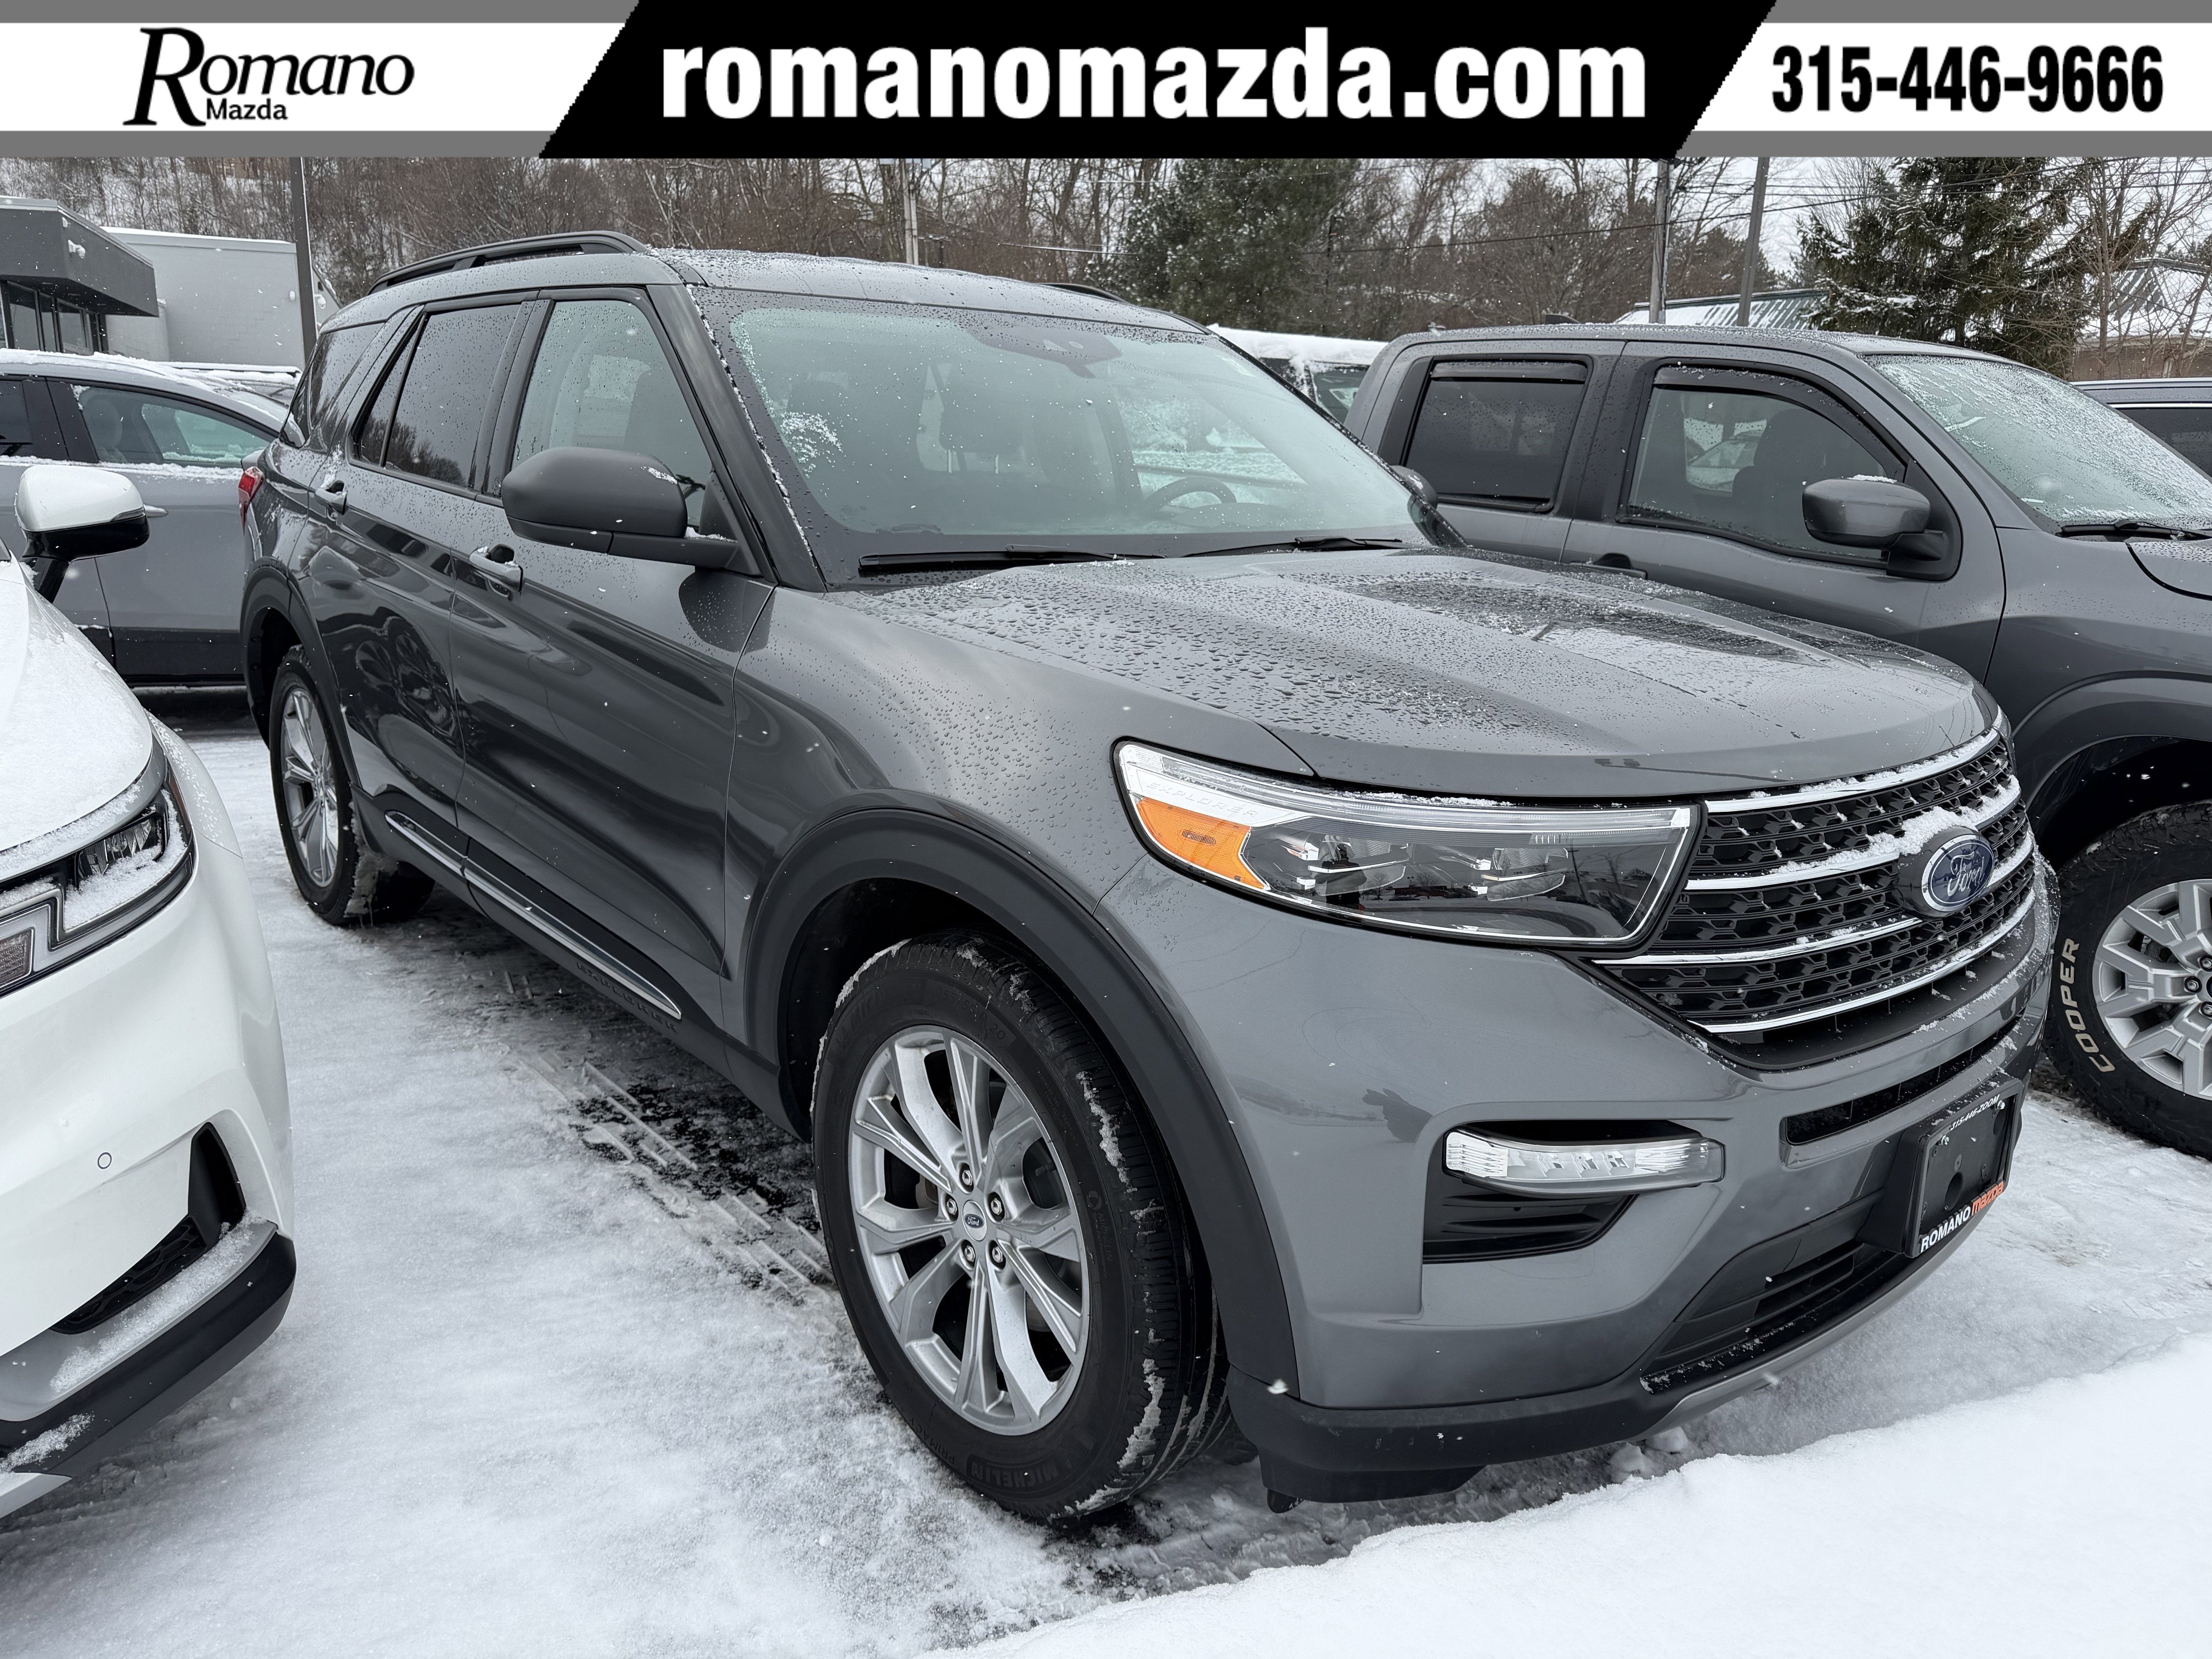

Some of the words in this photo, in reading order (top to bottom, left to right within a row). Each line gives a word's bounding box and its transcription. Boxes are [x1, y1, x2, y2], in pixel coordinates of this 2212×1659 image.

[1147, 782, 1258, 817] EXPLORER
[1947, 851, 1985, 897] Ford
[2060, 938, 2115, 1073] COOPER
[989, 1023, 1005, 1039] 20
[1950, 1094, 2000, 1131] 315-446-ZOOM
[967, 1216, 980, 1226] Ford
[1097, 1213, 1113, 1262] MICHELIN
[1920, 1206, 1971, 1253] ROMANO
[908, 1417, 955, 1465] PRIMACY
[970, 1460, 1058, 1489] MICHELIN
